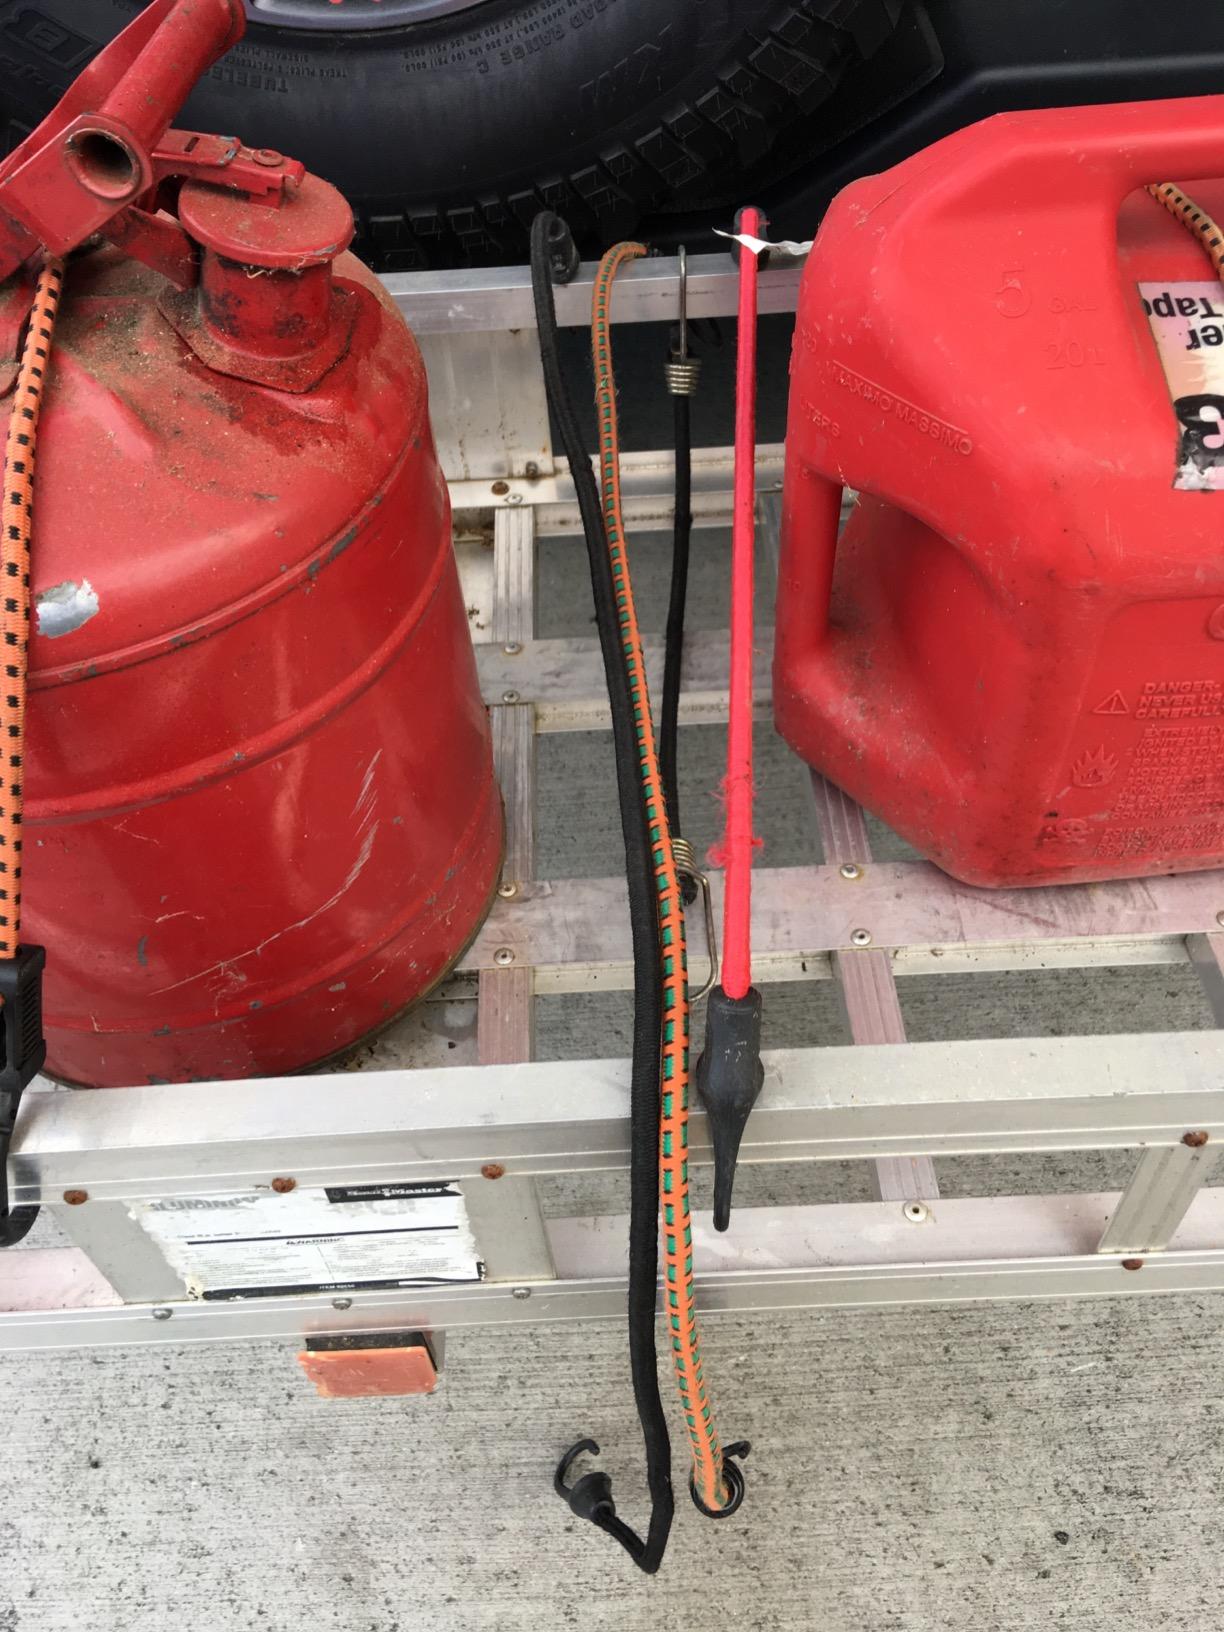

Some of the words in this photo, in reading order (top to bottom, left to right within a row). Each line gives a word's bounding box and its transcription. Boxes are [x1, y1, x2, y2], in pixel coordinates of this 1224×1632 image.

[1186, 324, 1224, 351] er
[895, 403, 973, 456] MASSIMO
[1138, 694, 1197, 708] NEVER
[1135, 705, 1224, 720] CAREFULL
